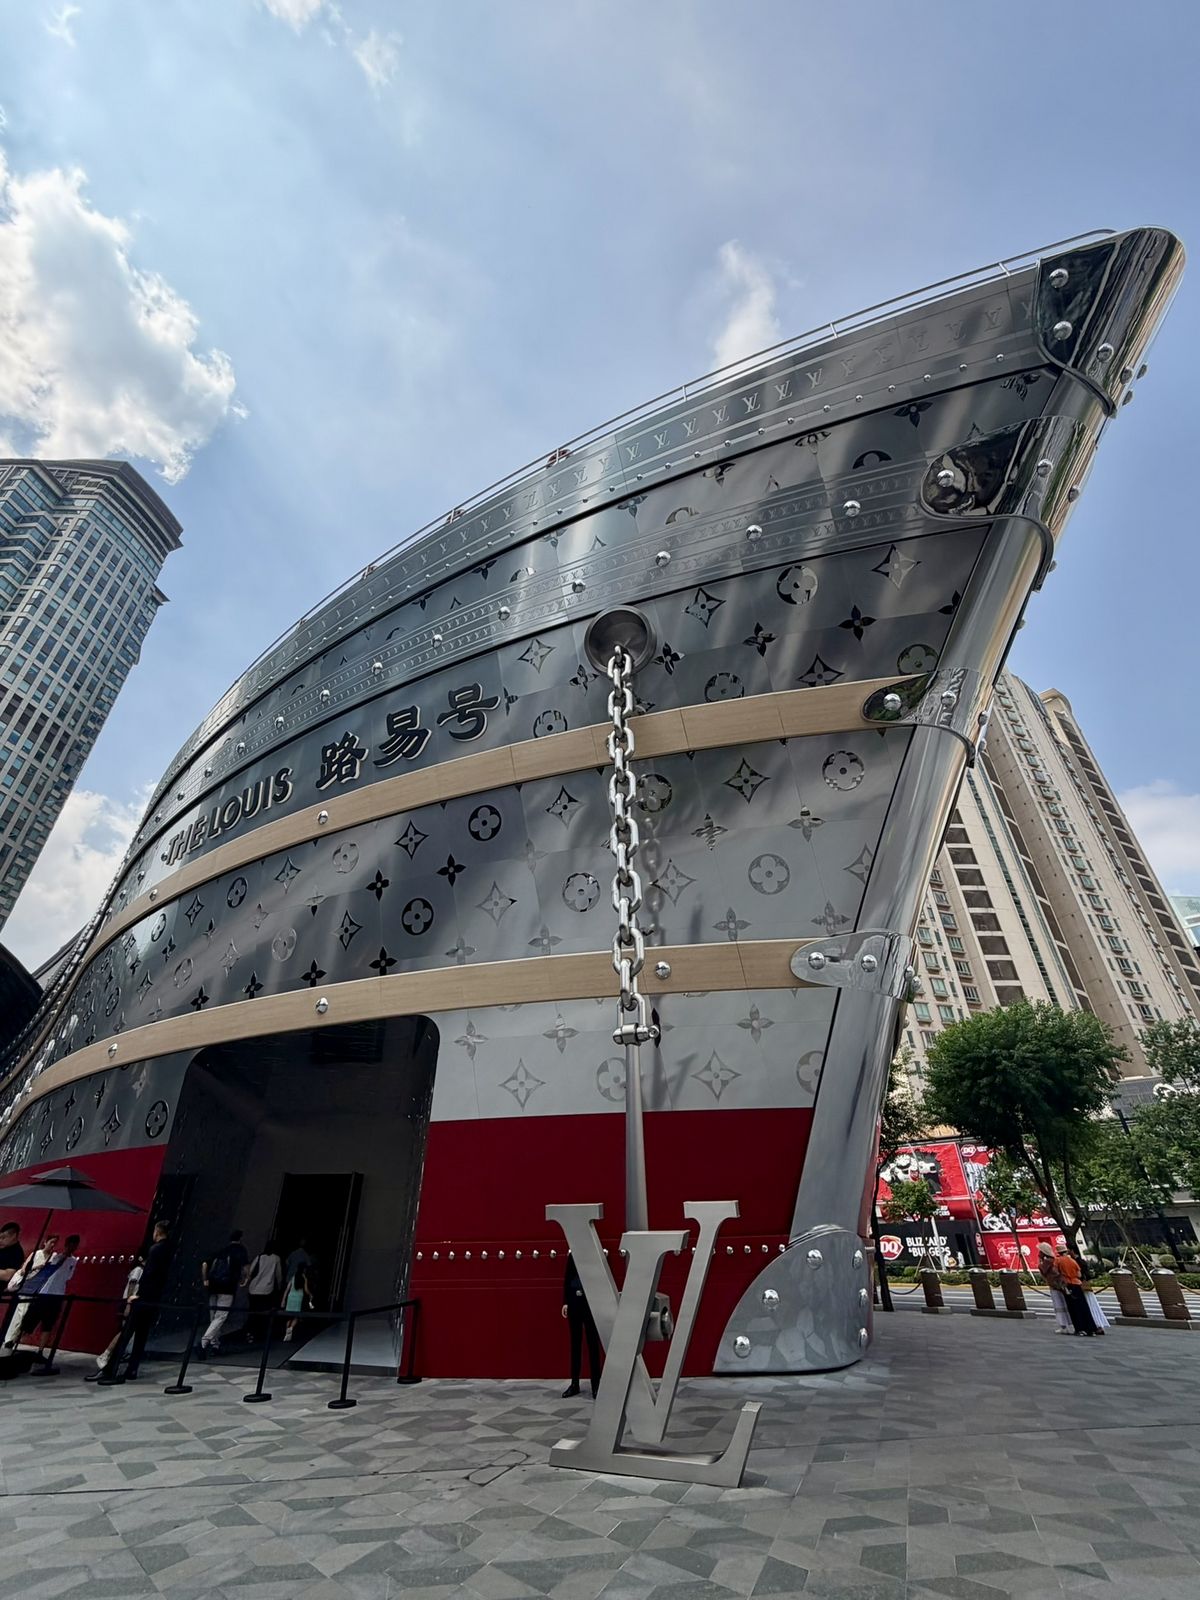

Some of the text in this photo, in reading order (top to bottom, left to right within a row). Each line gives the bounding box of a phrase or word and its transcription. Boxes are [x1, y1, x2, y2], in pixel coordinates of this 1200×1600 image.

[806, 368, 823, 388] LV
[774, 380, 793, 400] LV
[742, 392, 760, 413] LV
[712, 405, 729, 425] LV
[683, 418, 699, 437] LV
[654, 431, 670, 449] LV
[315, 682, 500, 790] 路易号
[165, 767, 293, 866] THE LOUIS
[905, 1236, 947, 1247] BLIZAD
[545, 1200, 763, 1488] LV
